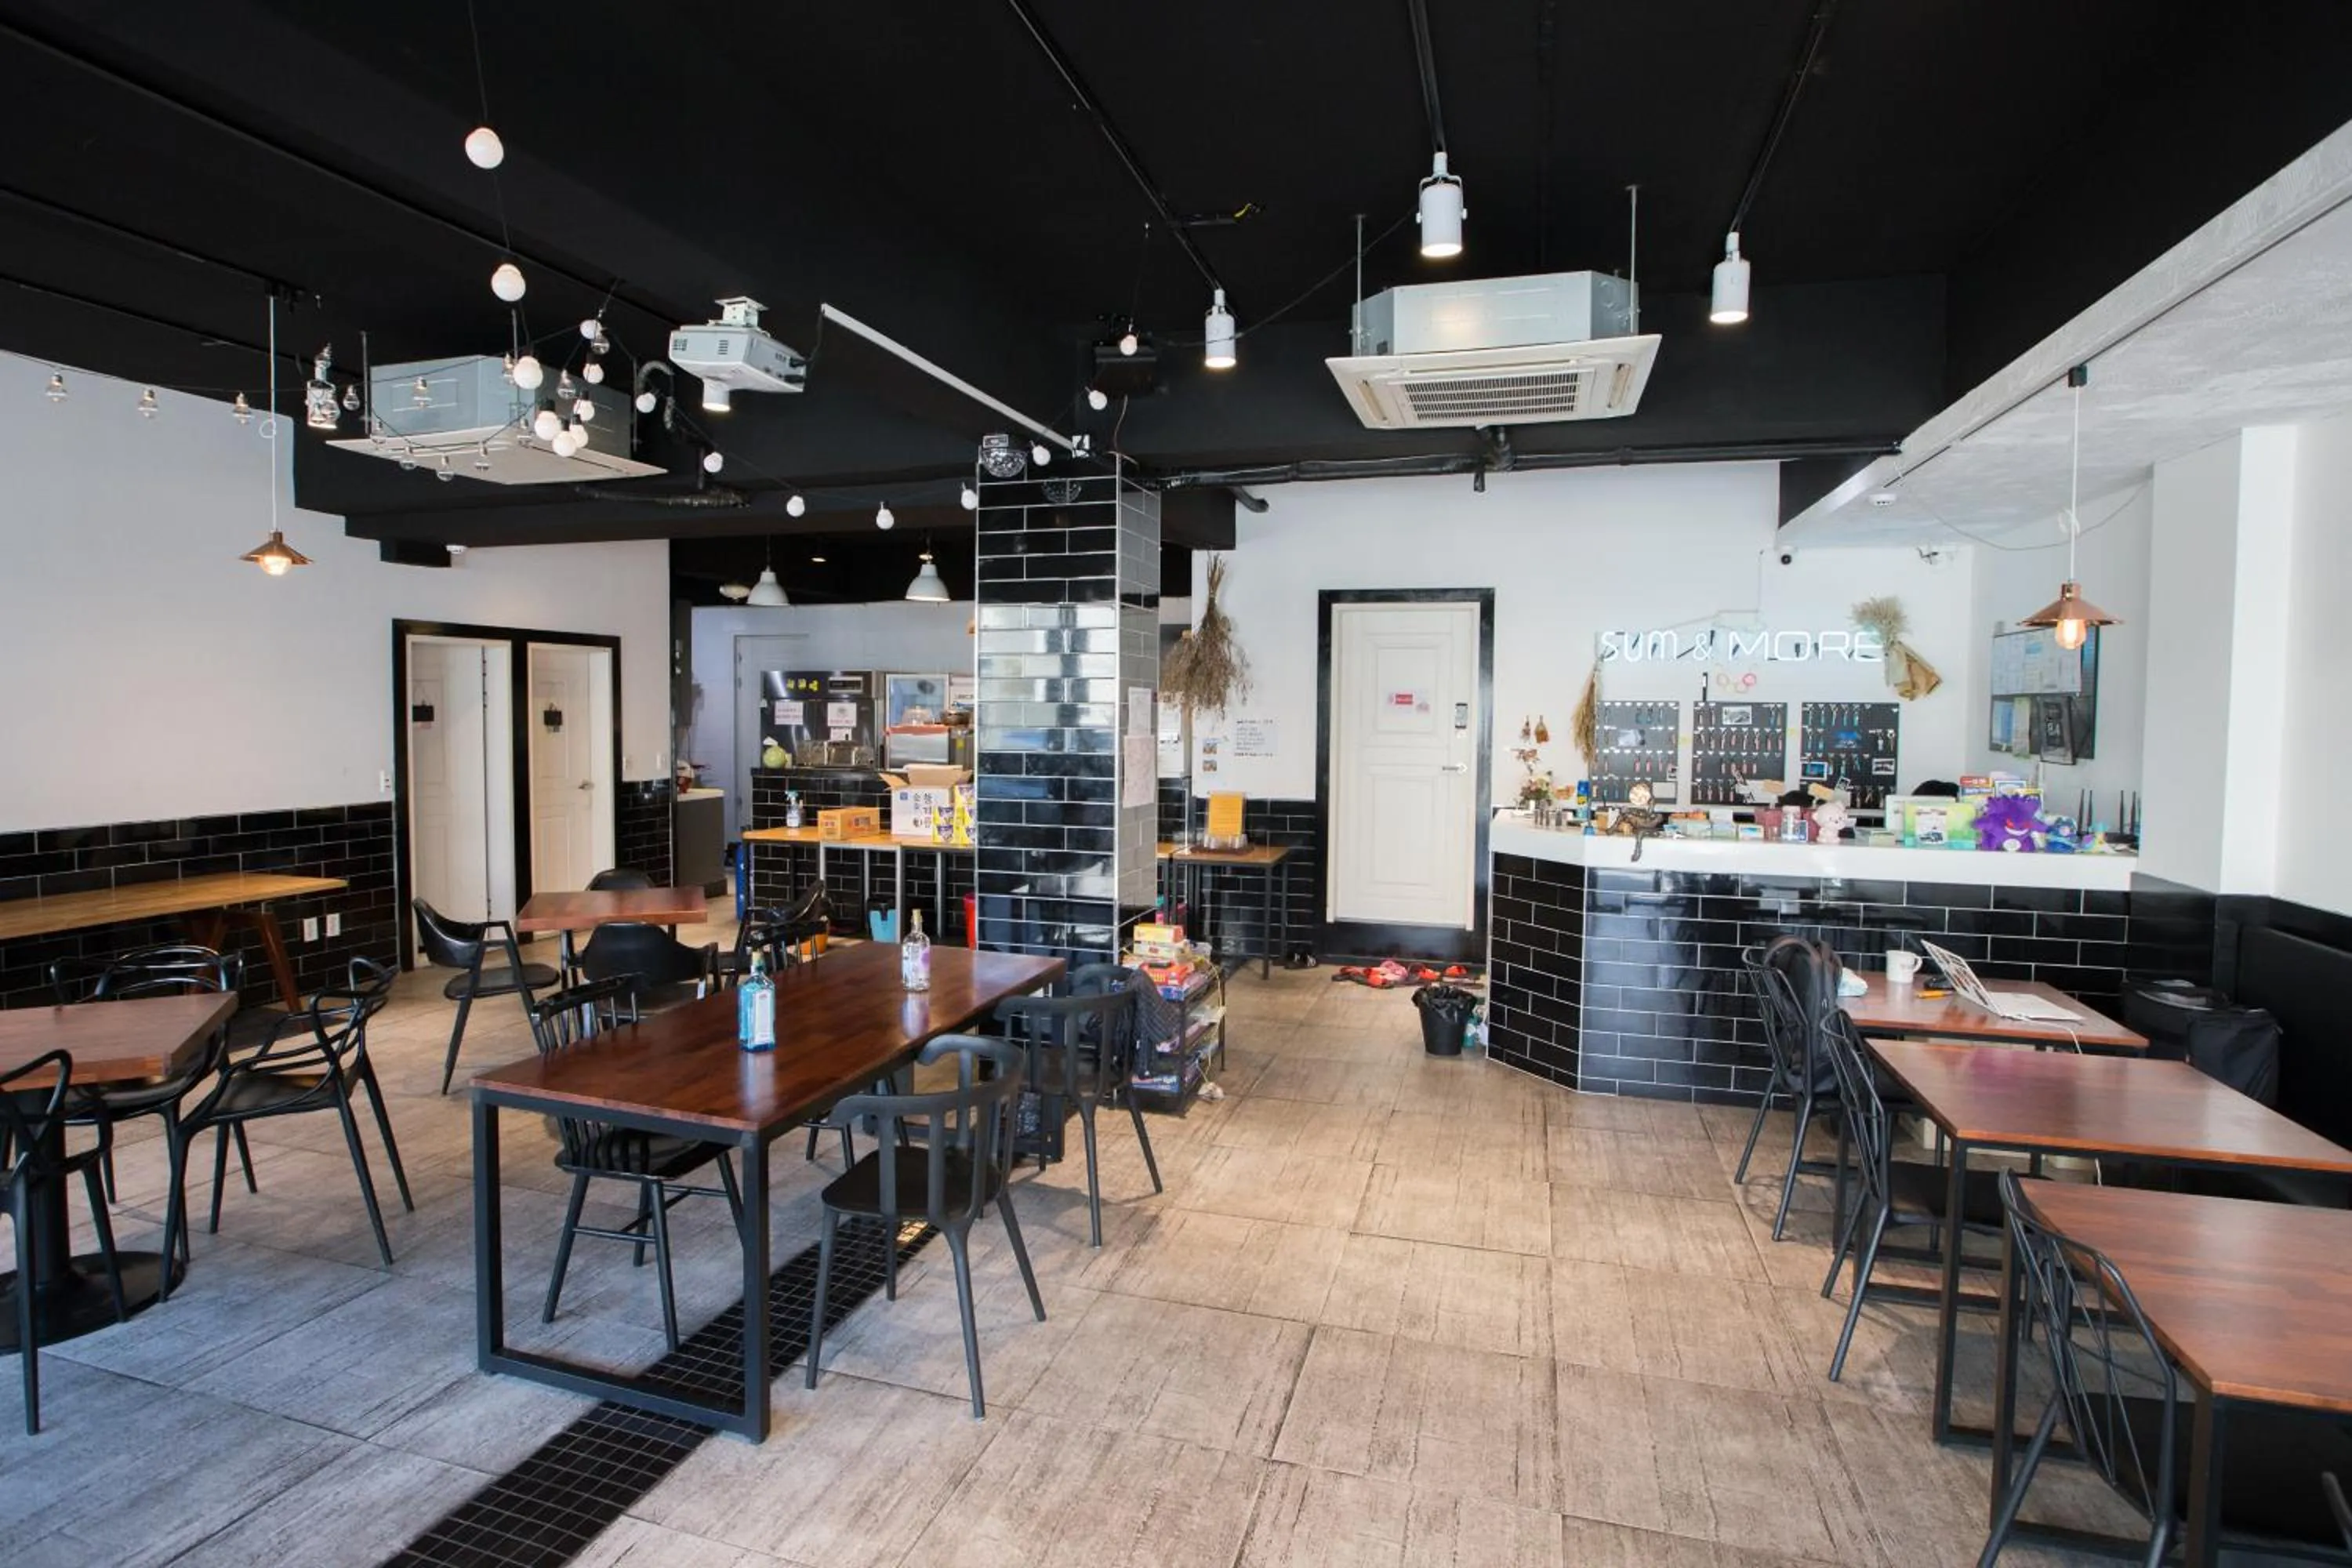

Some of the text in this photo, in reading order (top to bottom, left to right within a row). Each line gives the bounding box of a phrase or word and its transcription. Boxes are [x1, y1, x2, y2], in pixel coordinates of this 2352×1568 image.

[1601, 630, 1882, 662] SUM & MORE
